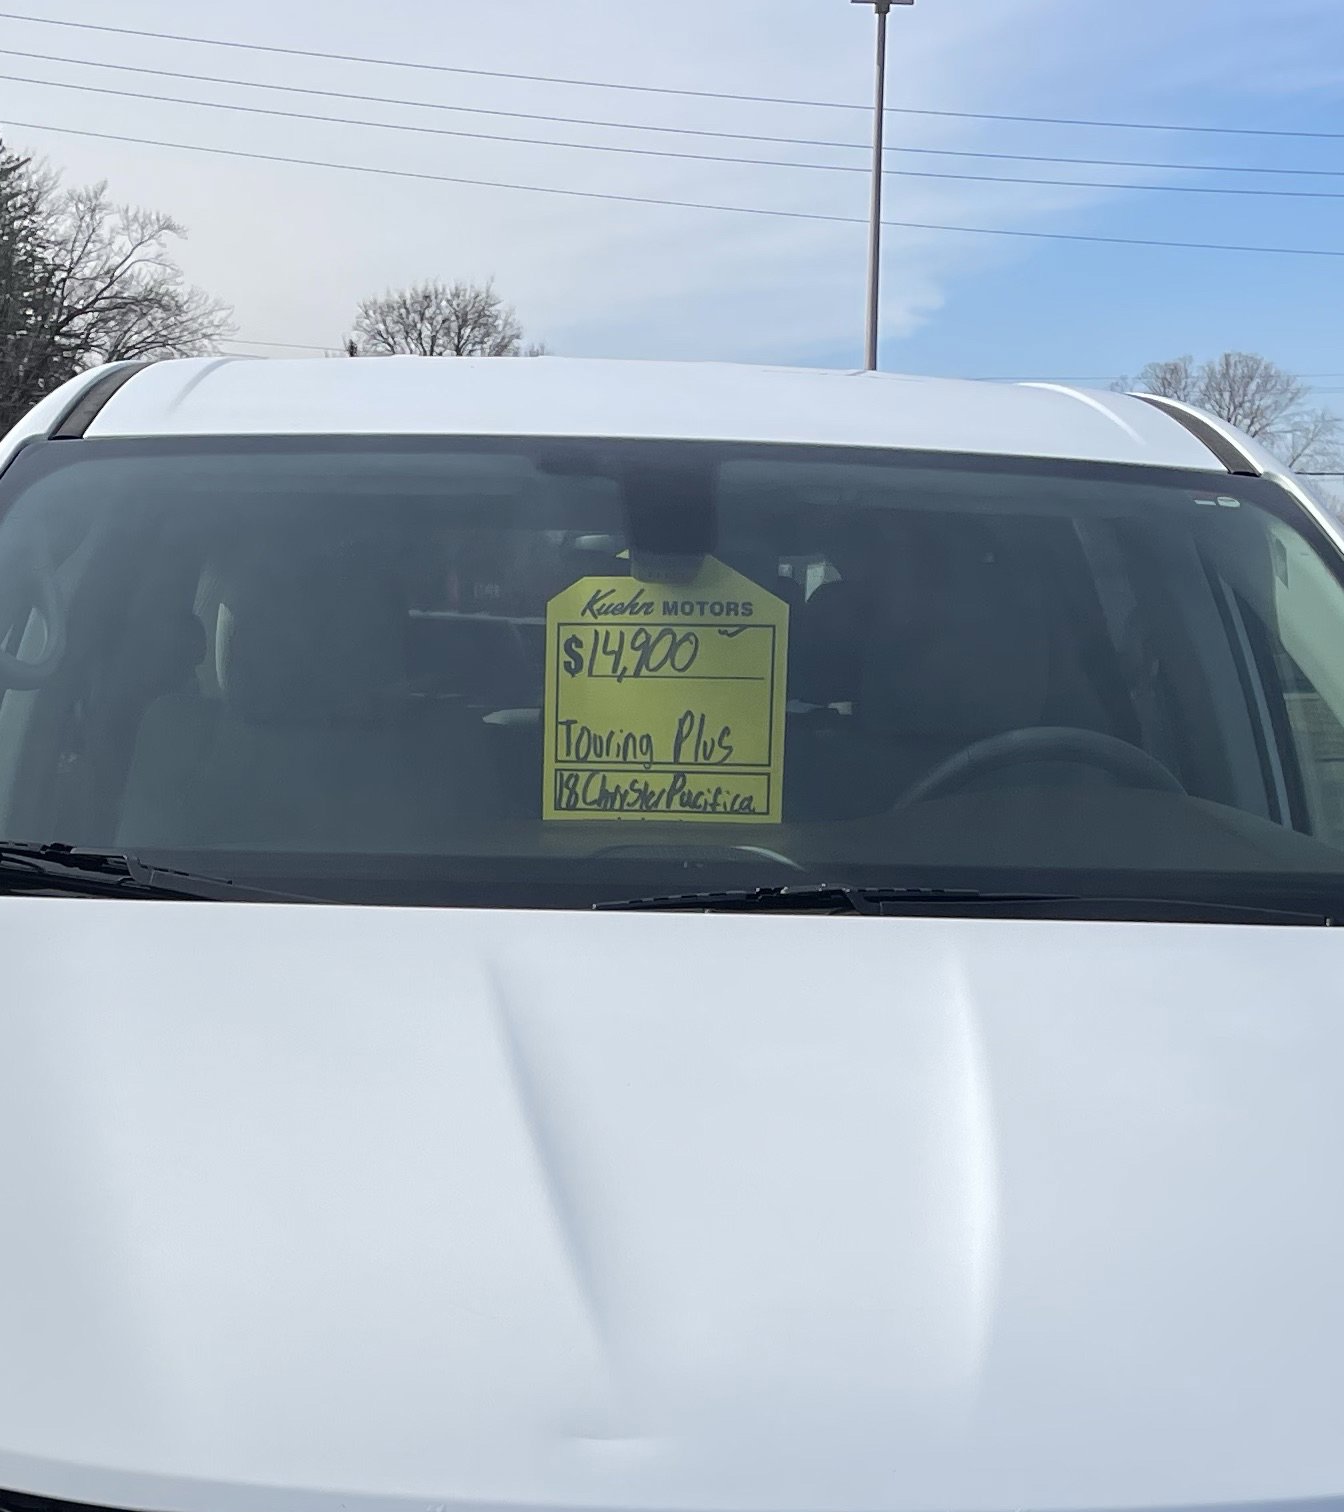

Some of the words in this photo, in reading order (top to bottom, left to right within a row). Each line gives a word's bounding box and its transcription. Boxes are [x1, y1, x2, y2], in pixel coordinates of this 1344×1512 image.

[580, 588, 655, 619] Kuehn
[662, 600, 754, 617] MOTORS
[558, 719, 654, 770] Touring
[673, 709, 734, 765] Plus
